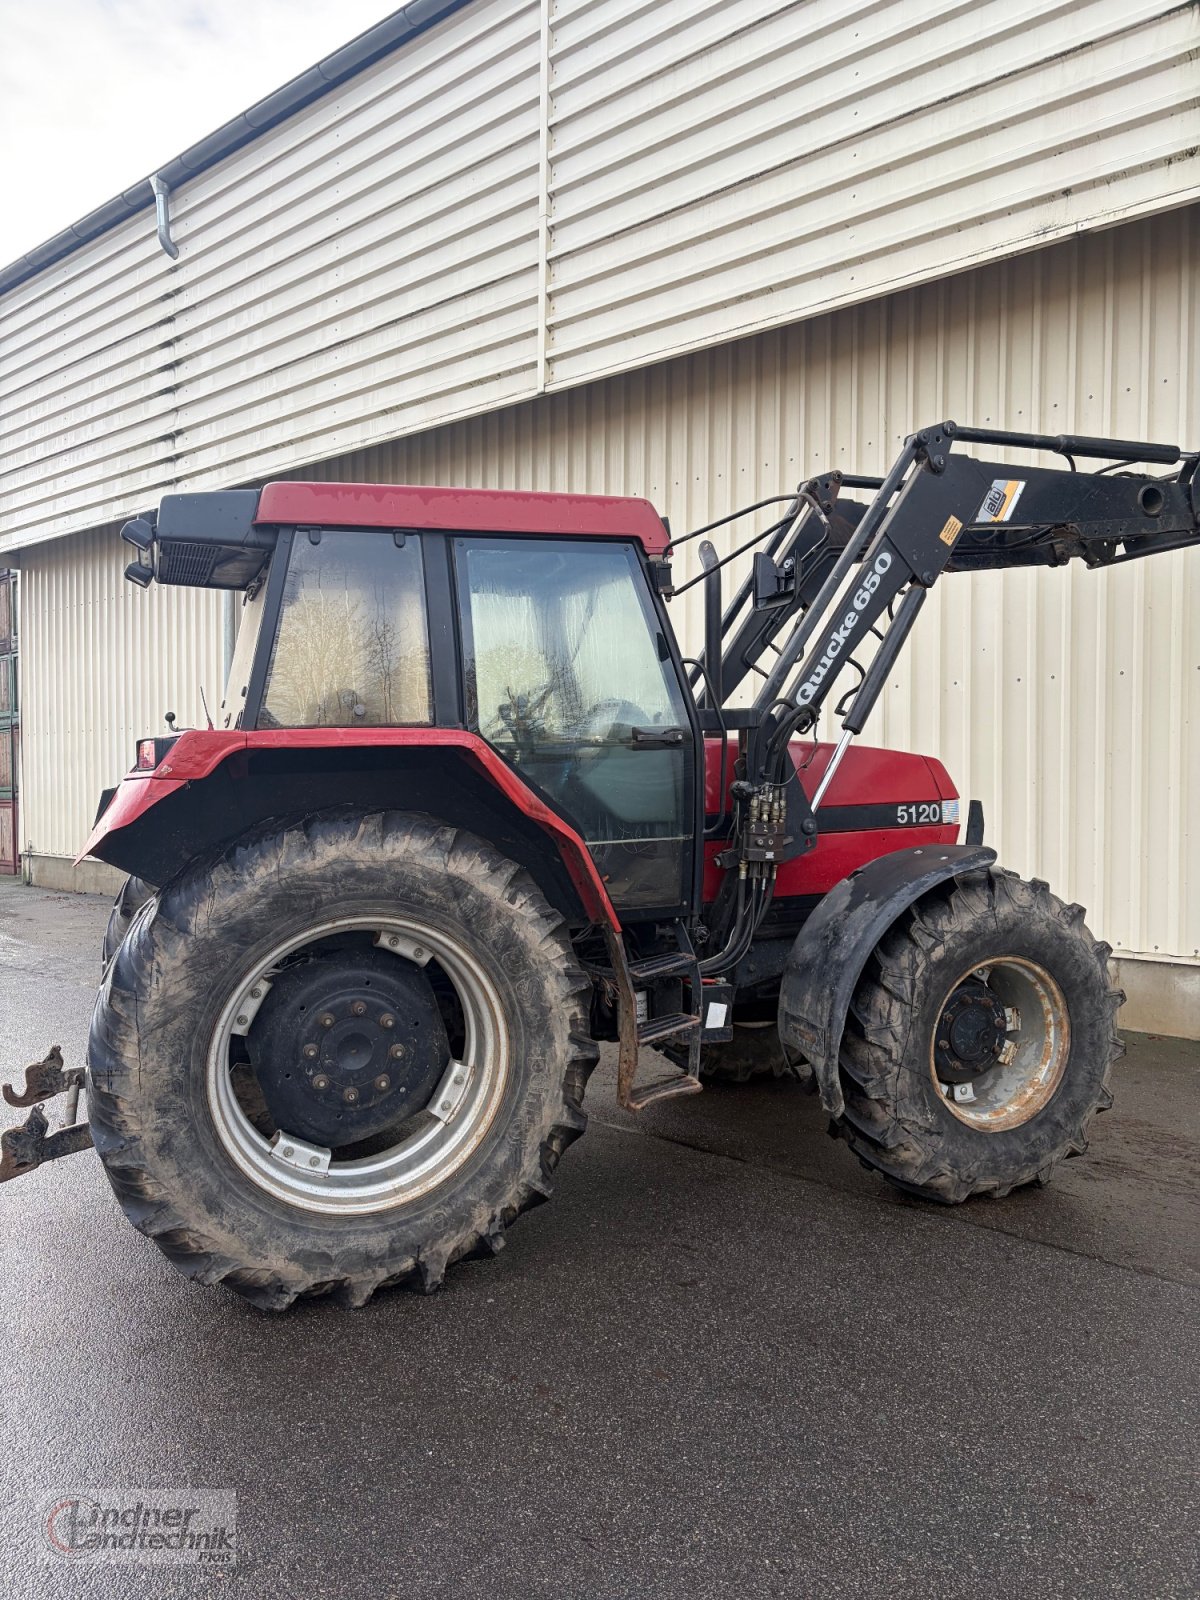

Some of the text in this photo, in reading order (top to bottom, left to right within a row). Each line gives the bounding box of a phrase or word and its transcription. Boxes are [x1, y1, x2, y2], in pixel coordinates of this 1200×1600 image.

[795, 552, 892, 706] Quicke 650
[896, 803, 940, 824] 5120
